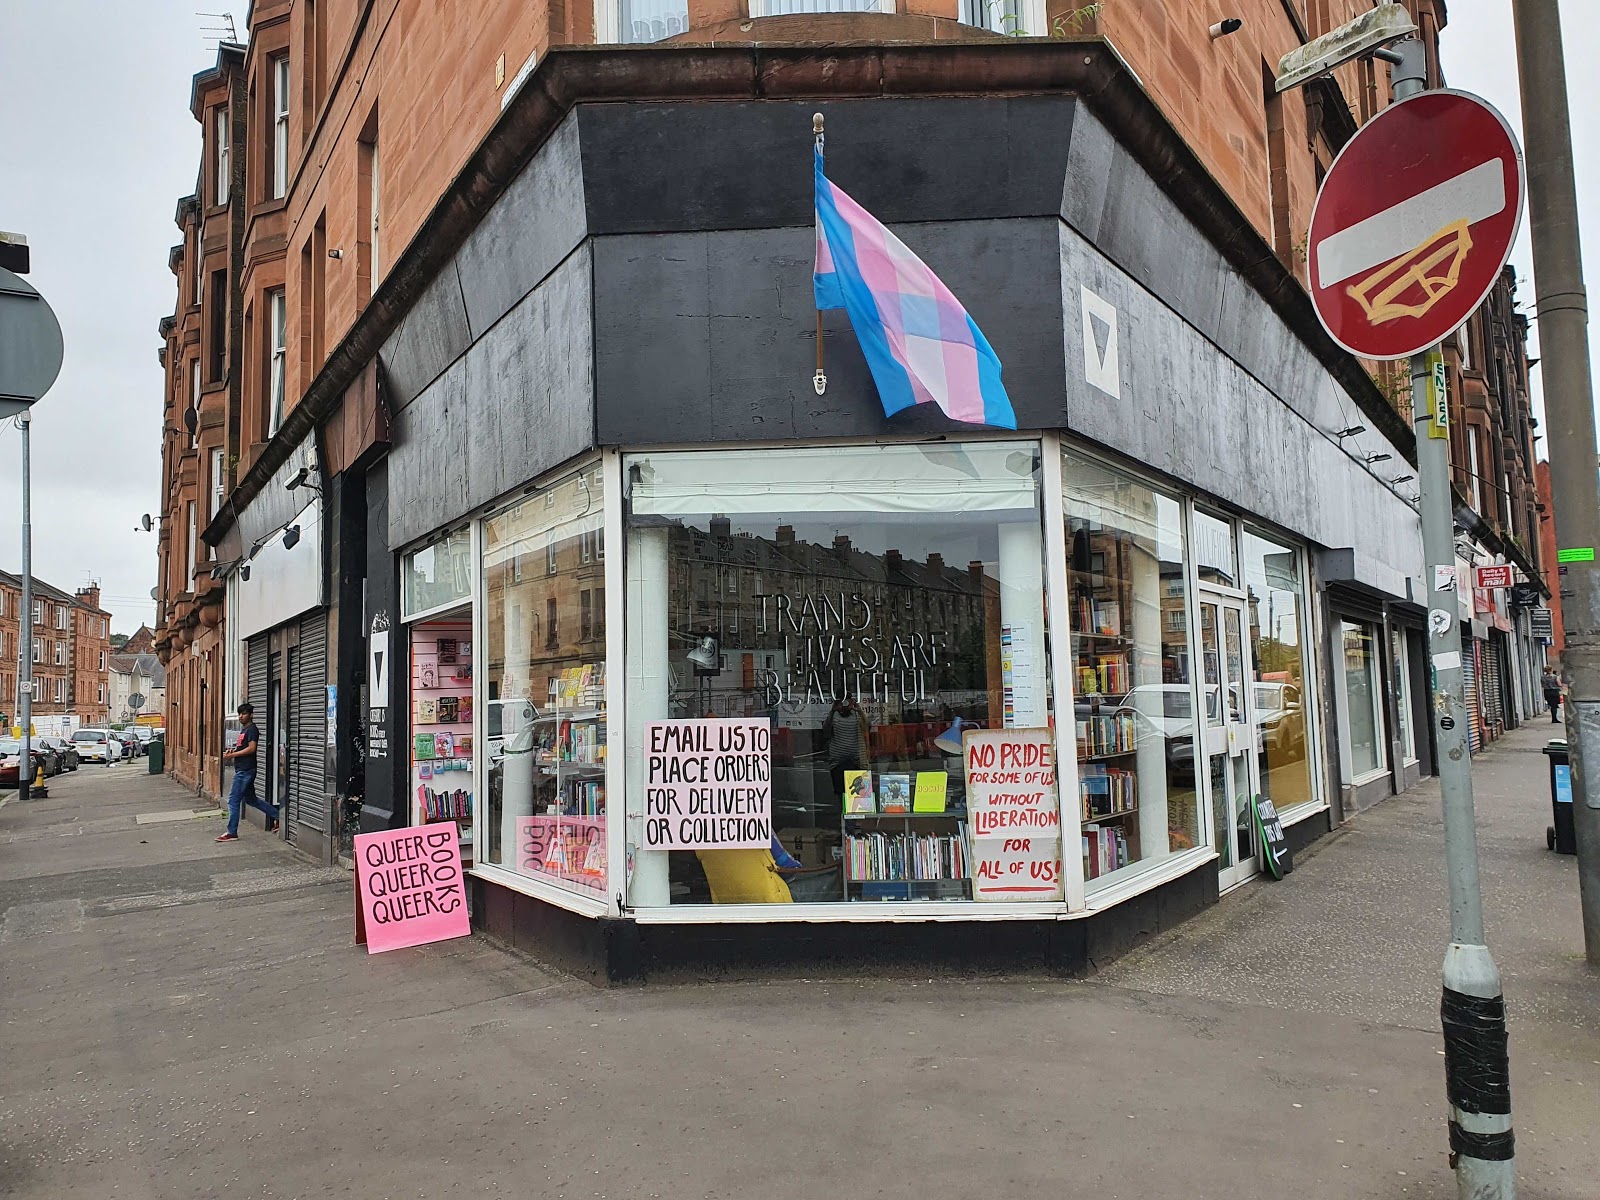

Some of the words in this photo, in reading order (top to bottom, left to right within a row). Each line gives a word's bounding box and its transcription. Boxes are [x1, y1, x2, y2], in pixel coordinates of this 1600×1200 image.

[717, 542, 734, 551] DEAD
[1483, 577, 1506, 586] mail
[752, 592, 871, 633] TRANS
[784, 635, 880, 670] LIVES
[765, 669, 935, 706] BEAUTIFUL
[651, 725, 714, 753] EMAIL
[719, 725, 746, 752] US
[749, 726, 769, 752] TO
[649, 756, 710, 784] PLACE
[714, 754, 770, 782] ORDERS
[969, 743, 996, 770] NO
[1000, 743, 1053, 770] PRIDE
[969, 771, 988, 785] FOR
[990, 771, 1021, 784] SOME
[1024, 771, 1041, 784] OF
[1040, 771, 1055, 786] US
[647, 788, 683, 816] FOR
[689, 787, 769, 815] DELIVERY
[988, 792, 1045, 806] WITHOUT
[646, 818, 674, 846] OR
[679, 817, 770, 844] COLLECTION
[975, 808, 1059, 835] LIBERATION
[366, 835, 428, 867] QUEER
[1003, 838, 1031, 853] FOR
[369, 862, 434, 898] QUEER
[427, 832, 461, 914] BOOKS
[977, 860, 1005, 880] ALL
[1009, 861, 1025, 875] OF
[1030, 859, 1061, 884] US!
[372, 890, 440, 924] QUEER
